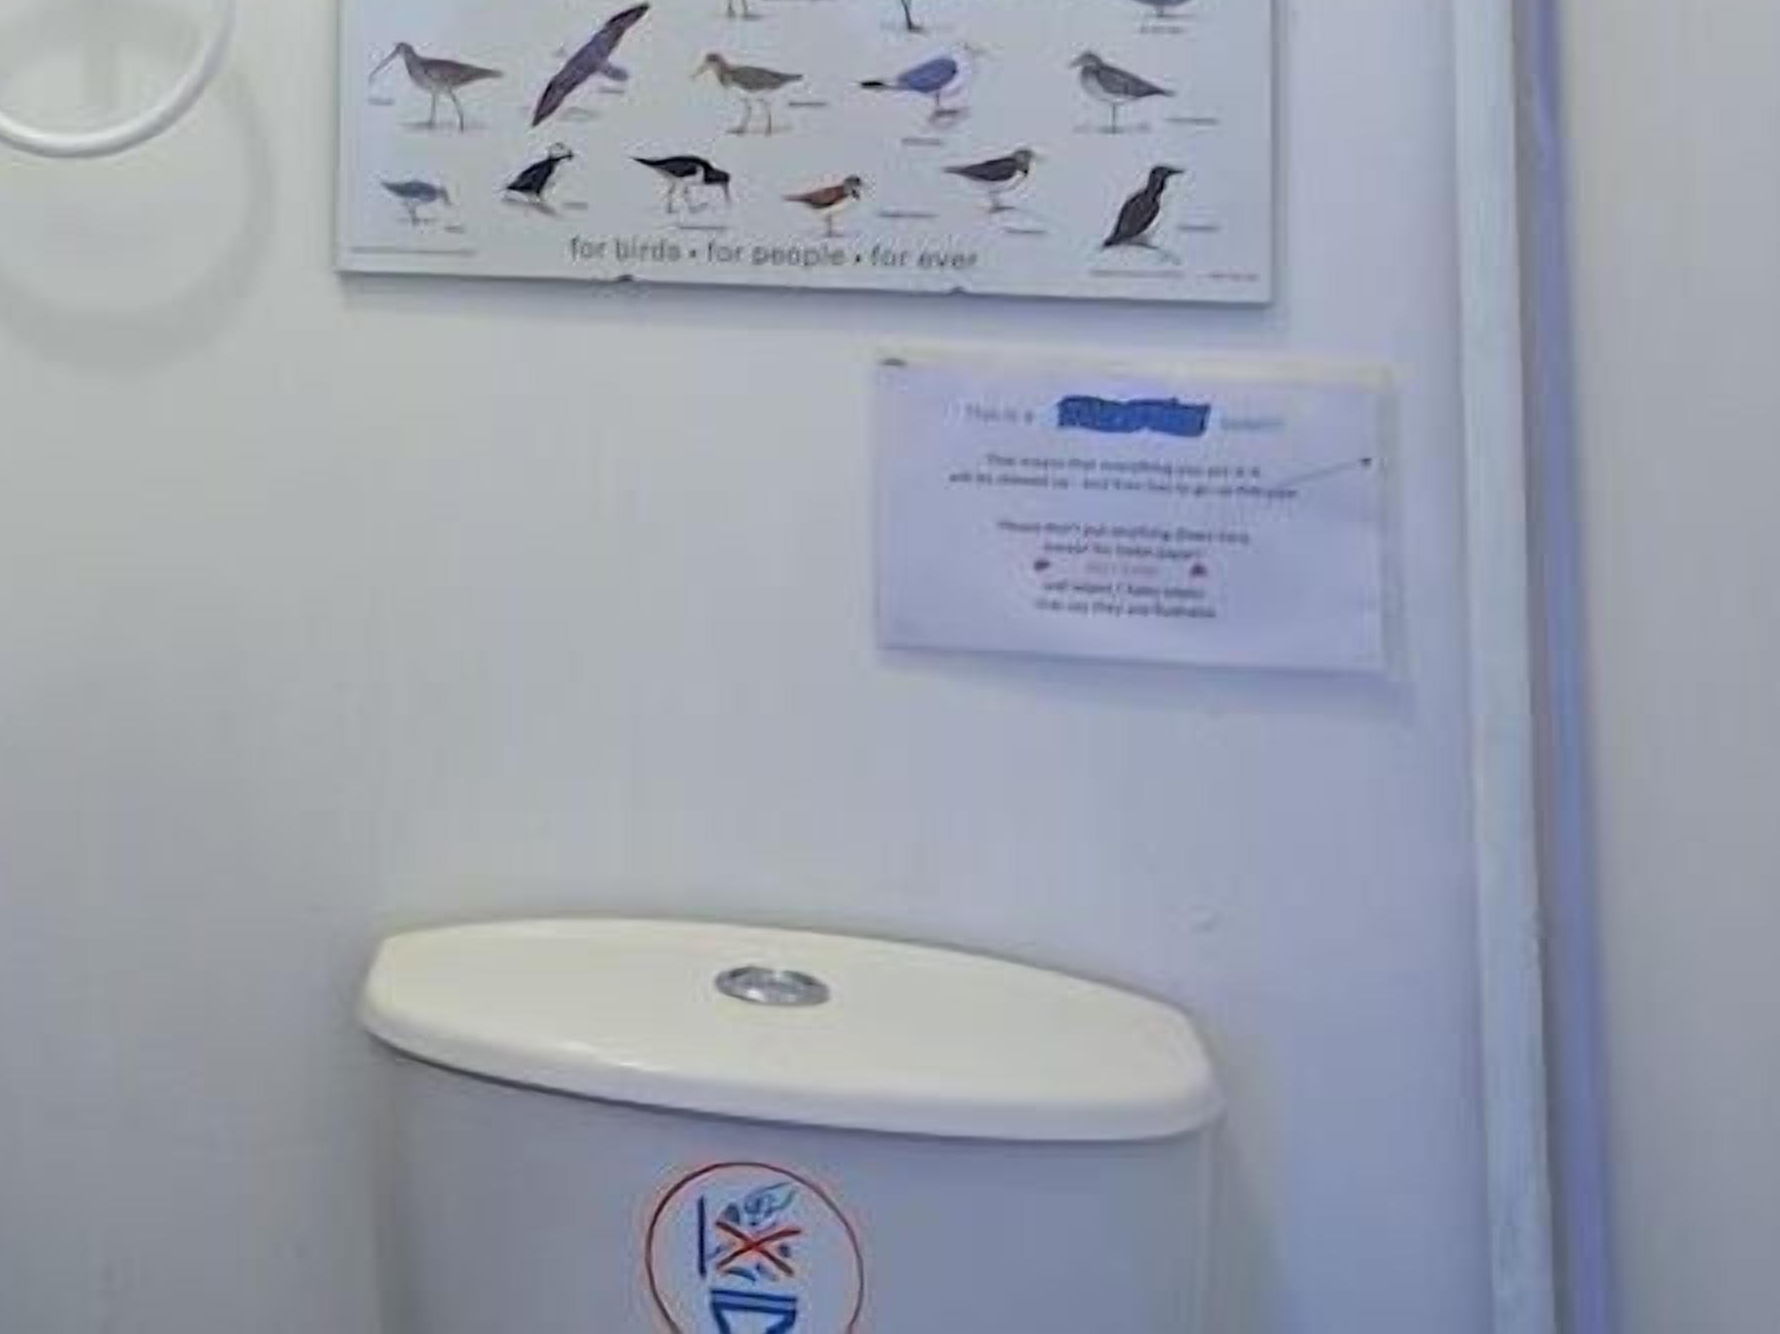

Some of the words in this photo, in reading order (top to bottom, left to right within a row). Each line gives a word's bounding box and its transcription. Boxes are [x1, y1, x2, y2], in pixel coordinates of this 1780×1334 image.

[570, 235, 608, 260] for
[615, 237, 682, 263] birds
[706, 241, 746, 263] for
[751, 243, 845, 270] people
[871, 244, 909, 267] for
[919, 250, 978, 269] ever
